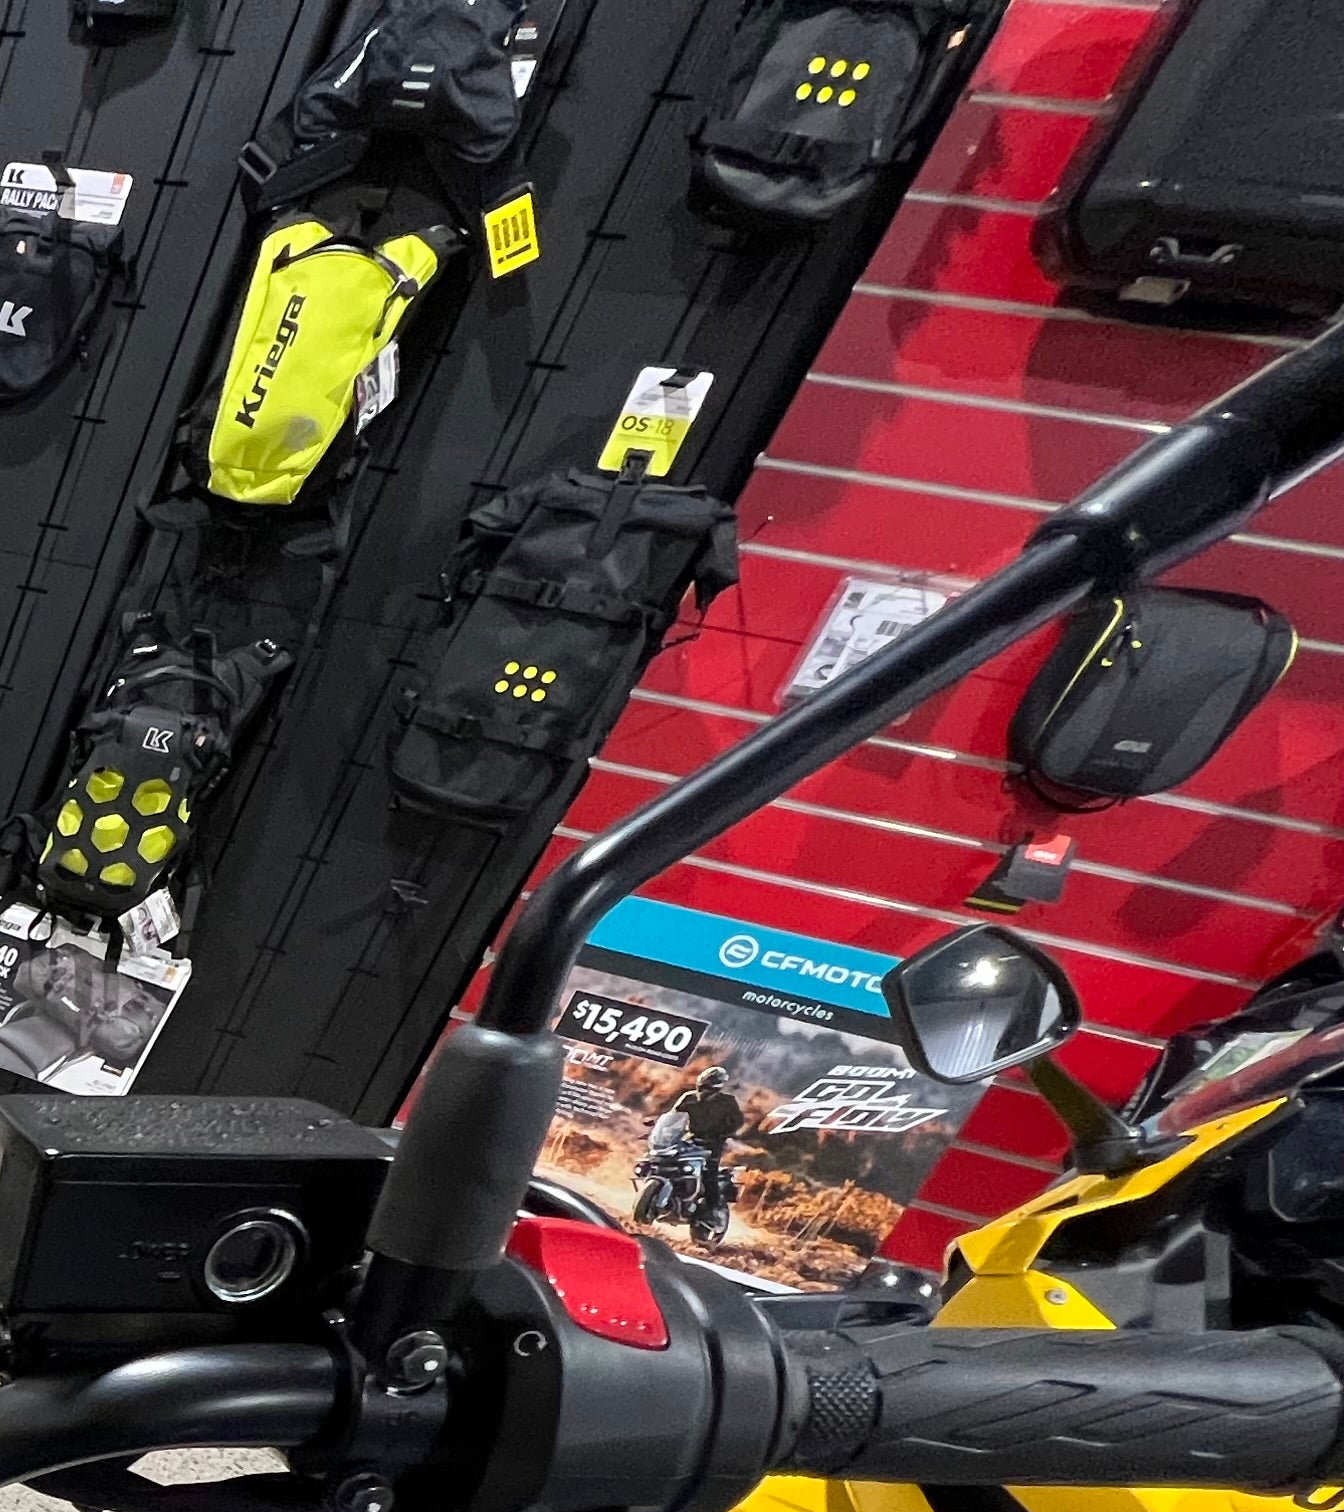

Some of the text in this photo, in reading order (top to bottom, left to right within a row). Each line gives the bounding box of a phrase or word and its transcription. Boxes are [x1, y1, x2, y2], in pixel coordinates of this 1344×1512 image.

[0, 187, 34, 208] RALLY
[234, 293, 308, 430] Kriega
[621, 414, 675, 436] OS-18
[759, 950, 885, 993] CFMOTO
[741, 989, 834, 1021] motorcycles
[572, 998, 693, 1054] $15,490
